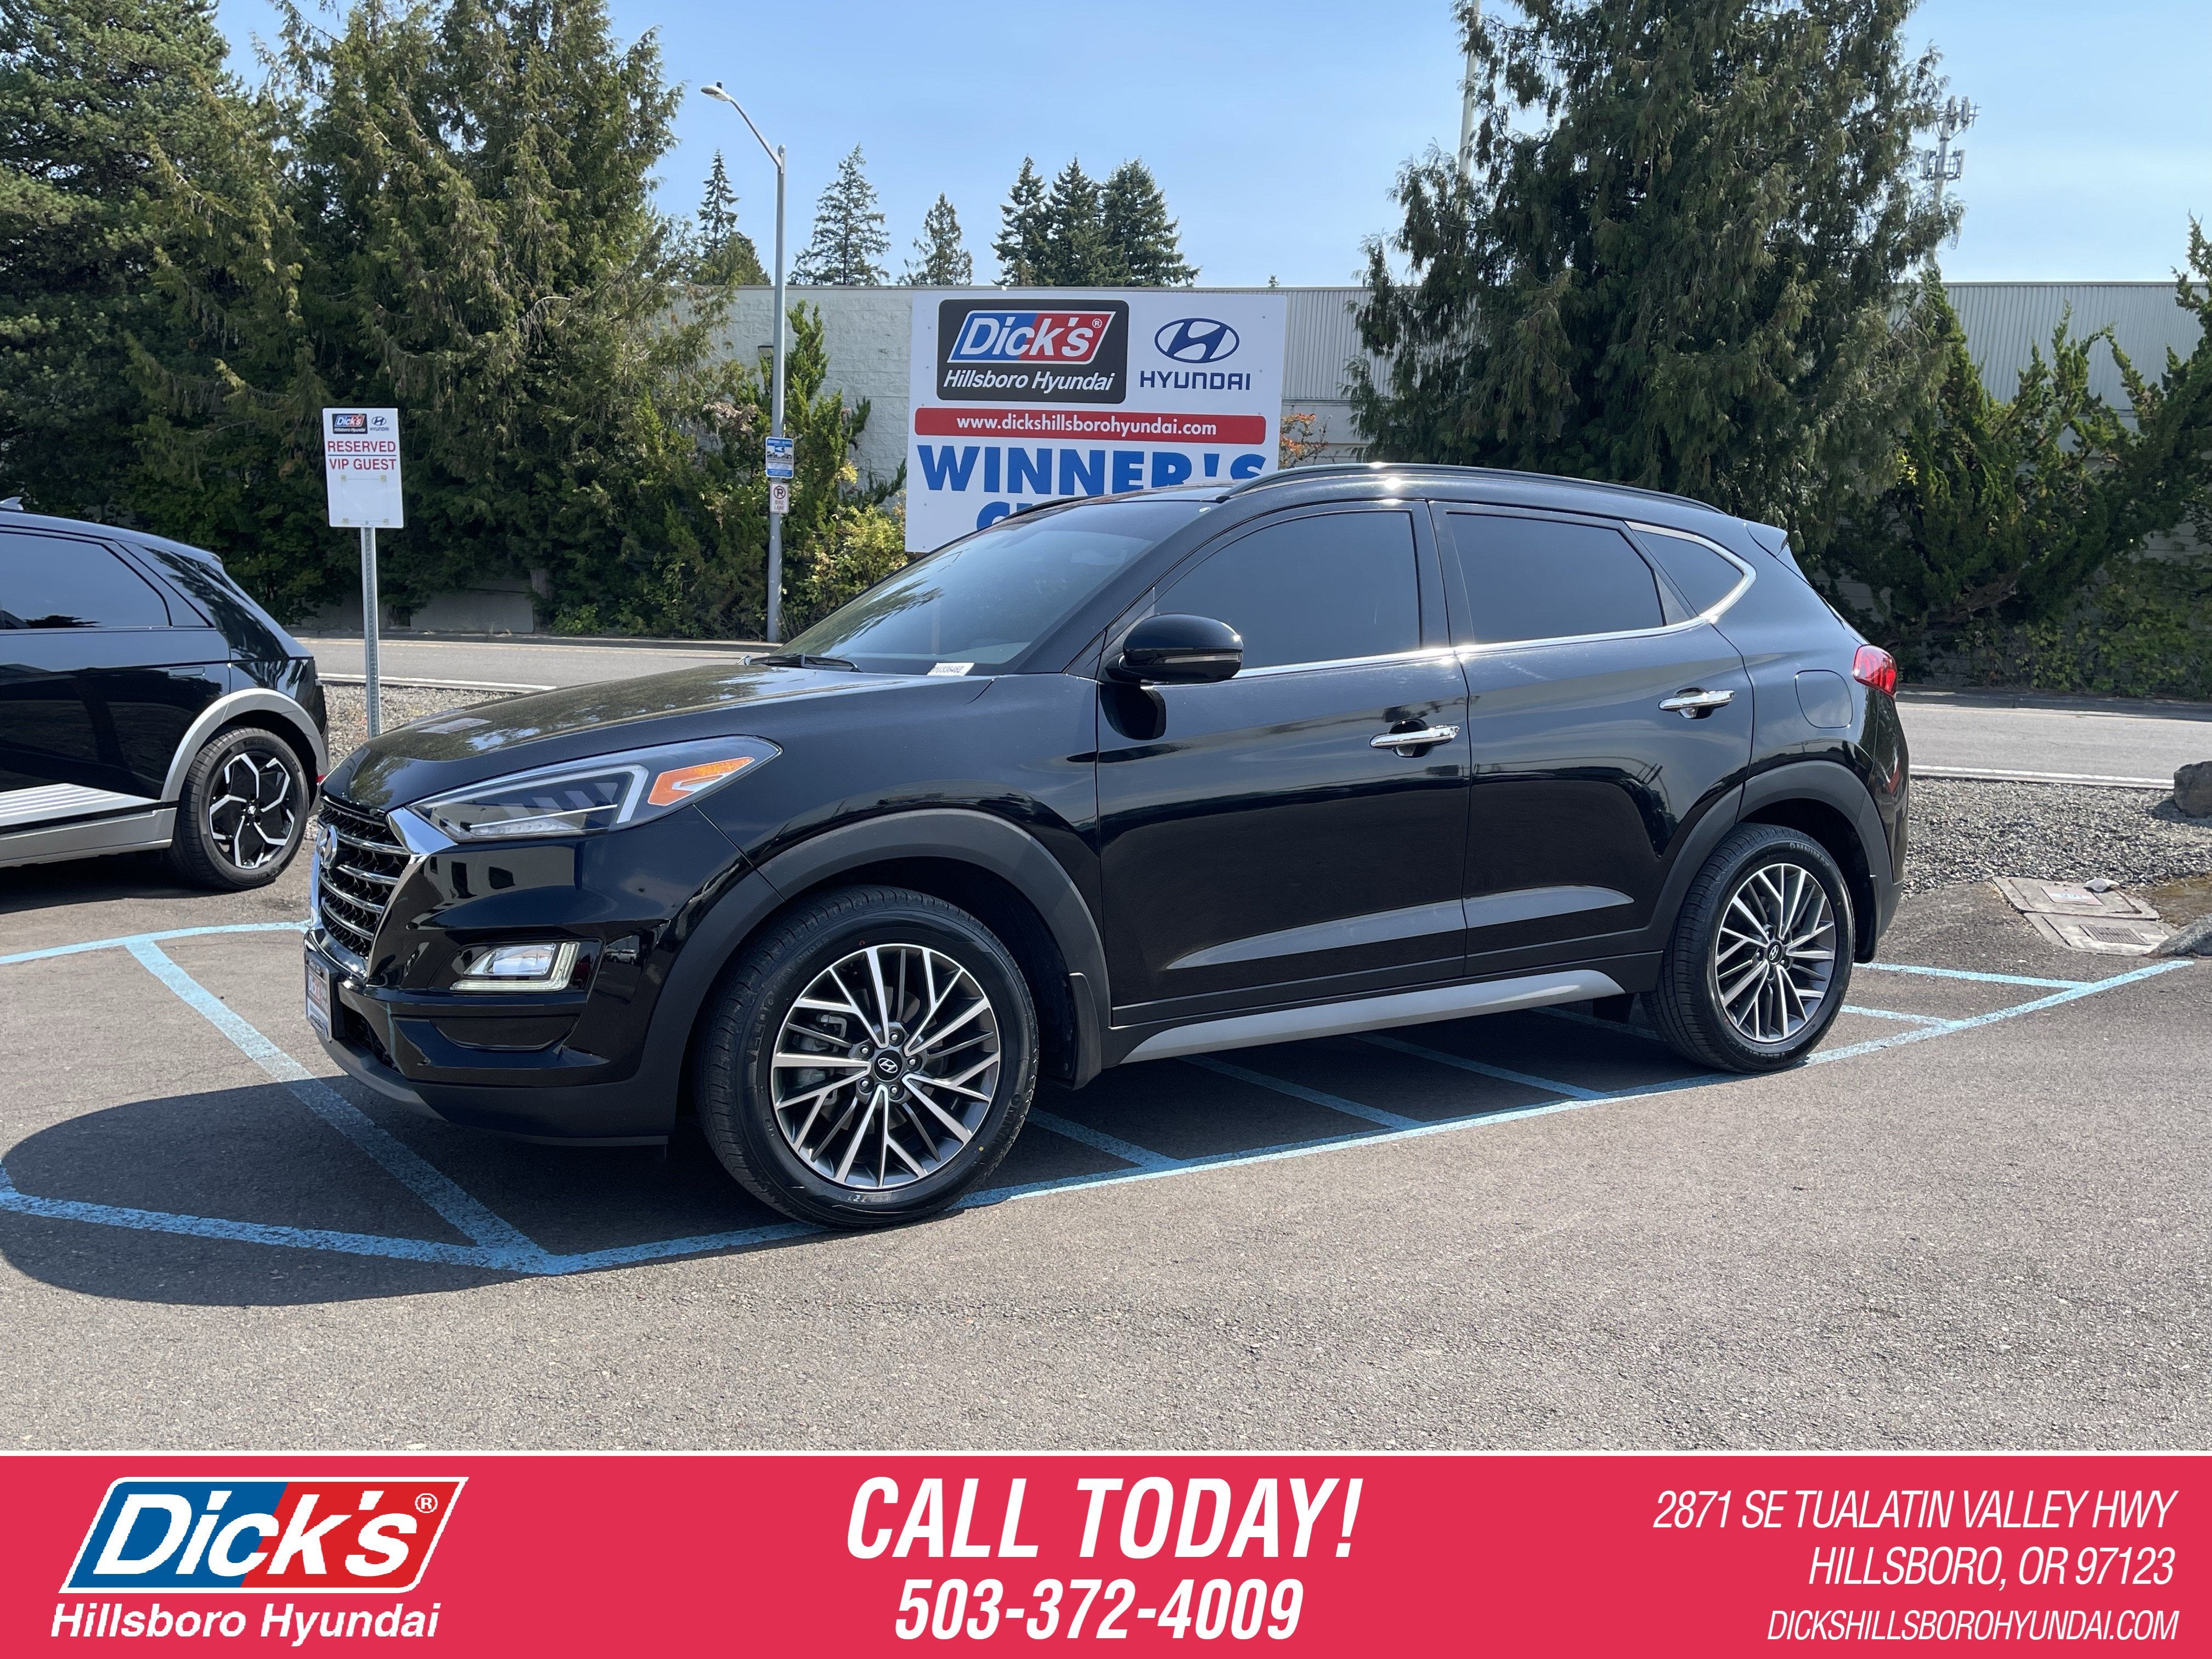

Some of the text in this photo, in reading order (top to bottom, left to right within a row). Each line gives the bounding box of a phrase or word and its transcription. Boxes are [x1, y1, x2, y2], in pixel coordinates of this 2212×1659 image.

[943, 369, 1115, 394] Hillsboro Hyundai
[1140, 370, 1251, 391] HYUNDAI
[957, 413, 1217, 437] www.dickshillsborohyundai.com
[328, 441, 396, 453] RESERVED
[329, 458, 397, 470] VIP GUEST
